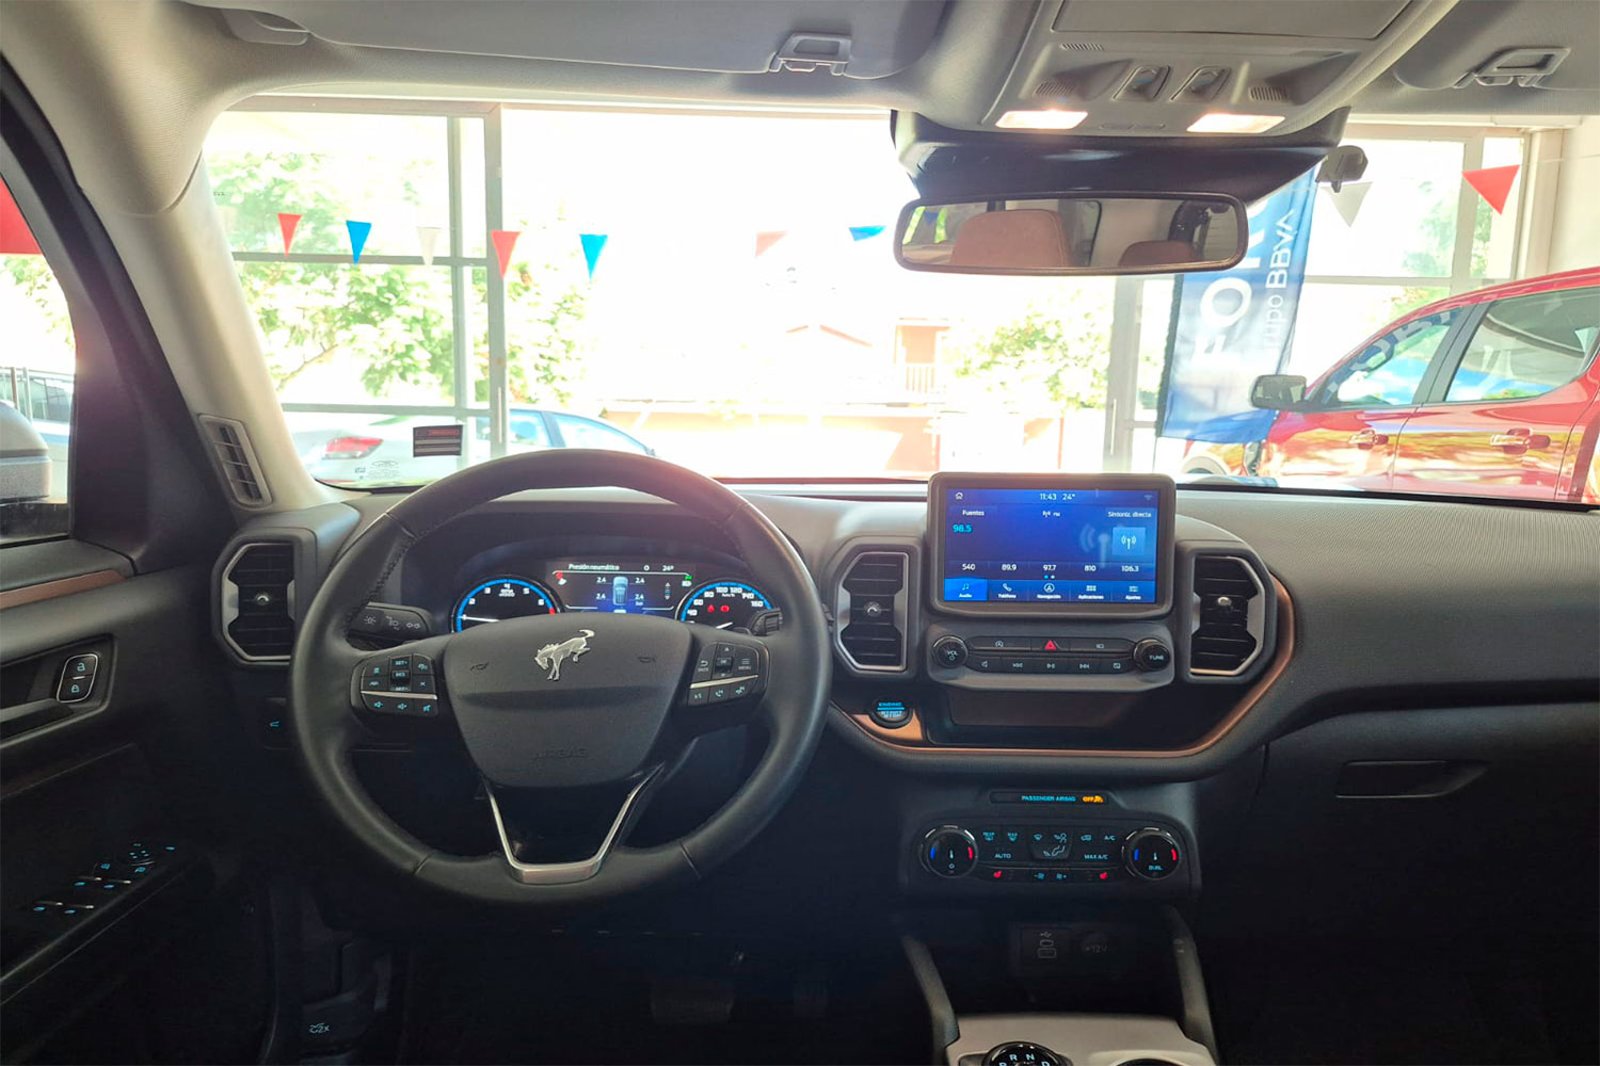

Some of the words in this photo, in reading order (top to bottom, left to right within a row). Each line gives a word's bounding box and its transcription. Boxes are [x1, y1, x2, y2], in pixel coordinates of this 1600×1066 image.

[1265, 208, 1297, 289] BBVA
[952, 523, 973, 533] 98.5
[962, 563, 976, 571] 540
[1001, 563, 1017, 571] 89.9
[1084, 564, 1097, 572] 810
[1009, 1053, 1018, 1061] R
[1026, 1053, 1035, 1061] N
